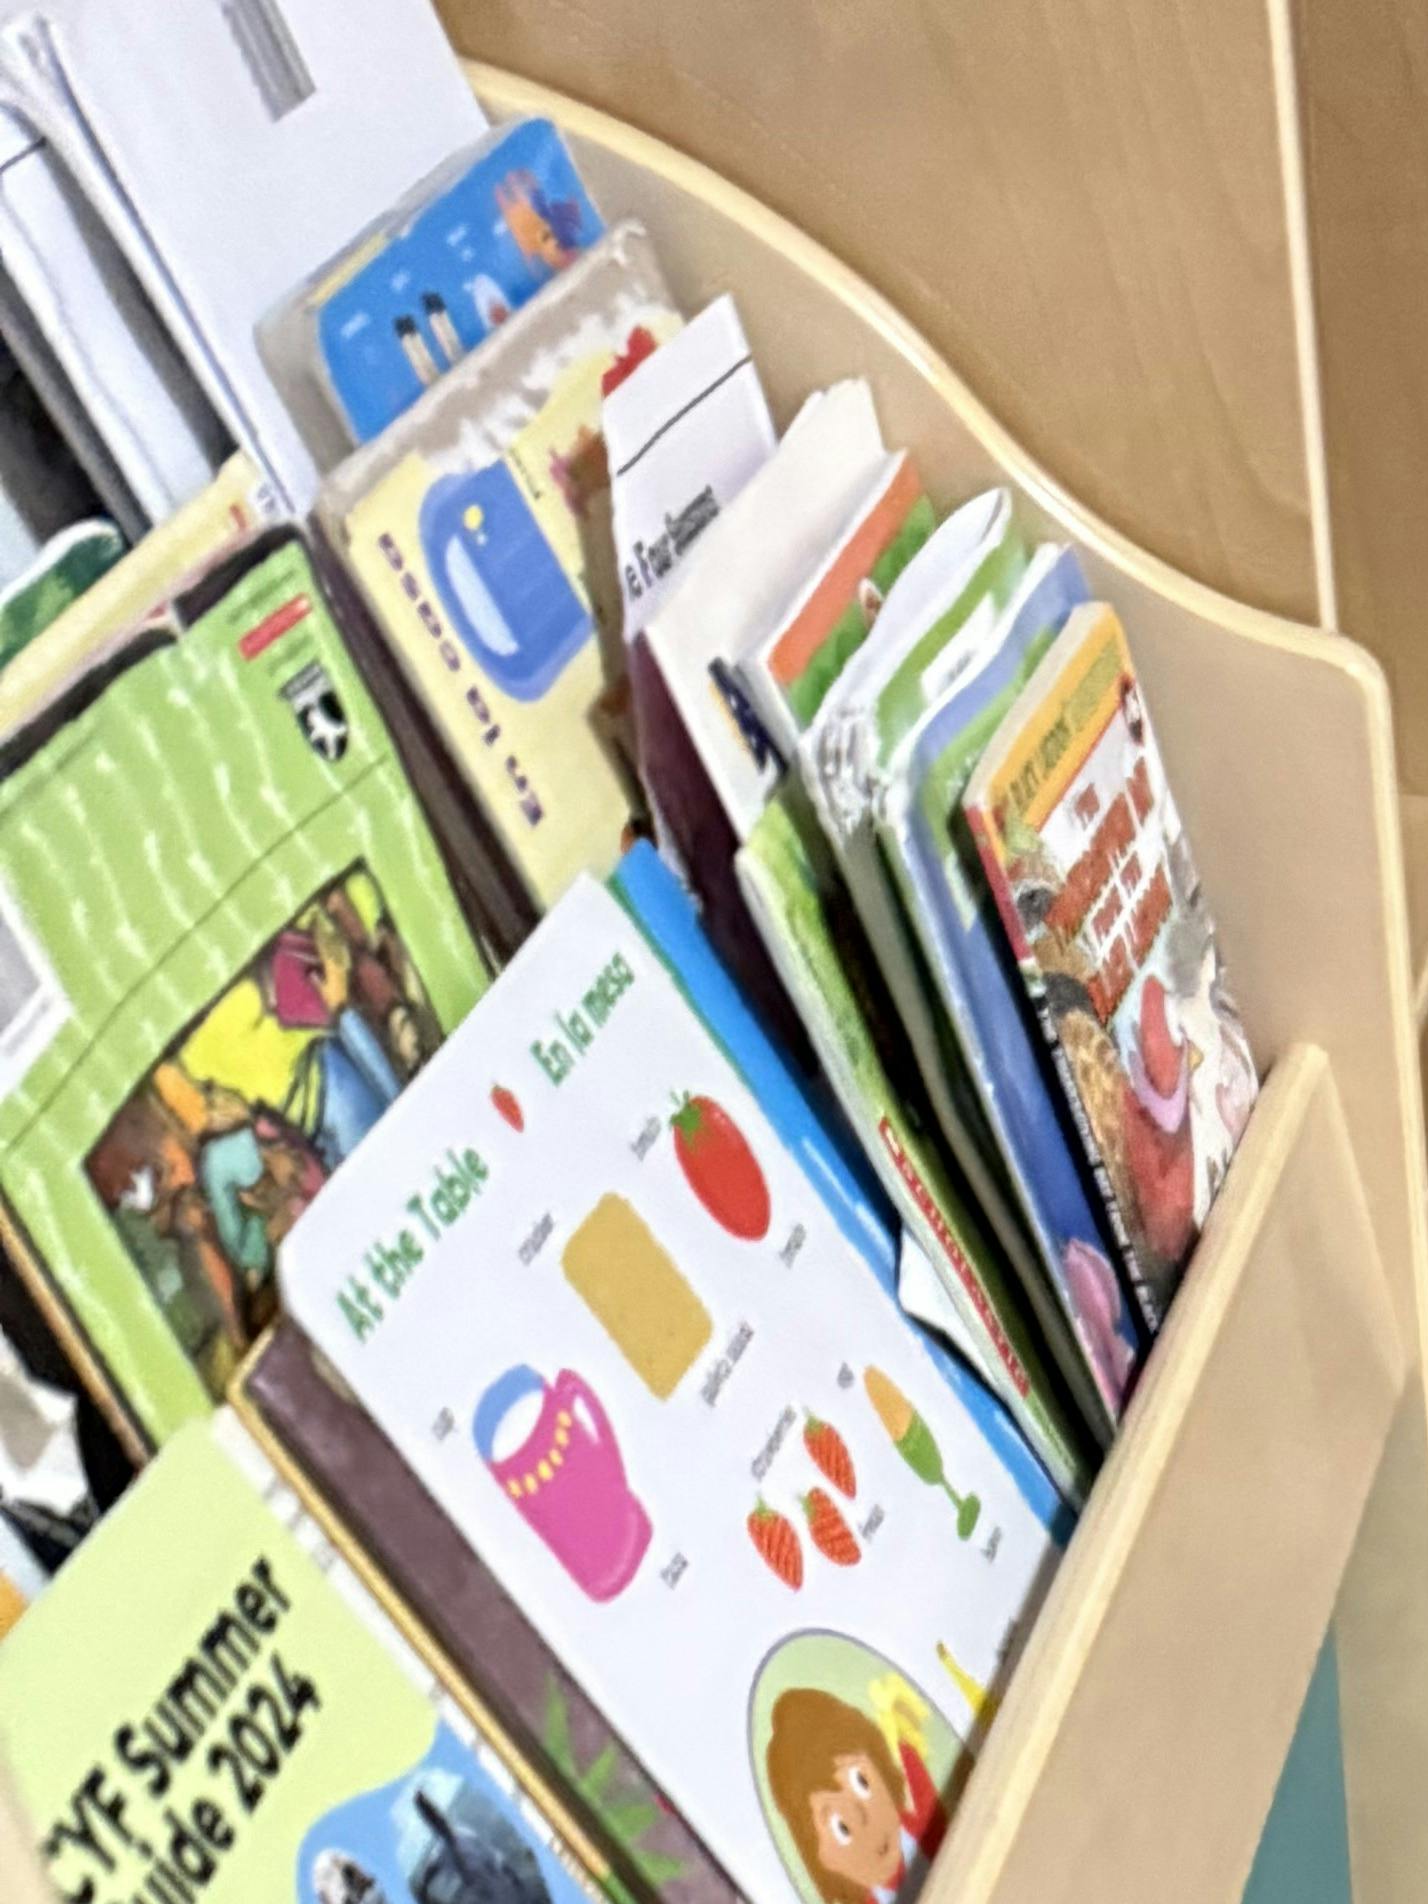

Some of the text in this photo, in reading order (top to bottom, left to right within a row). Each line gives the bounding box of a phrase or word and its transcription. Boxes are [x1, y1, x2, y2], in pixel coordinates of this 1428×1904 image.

[529, 950, 636, 1087] En la mesa
[335, 1147, 489, 1344] At the Table
[112, 1550, 293, 1798] Summer
[206, 1650, 323, 1816] 2024
